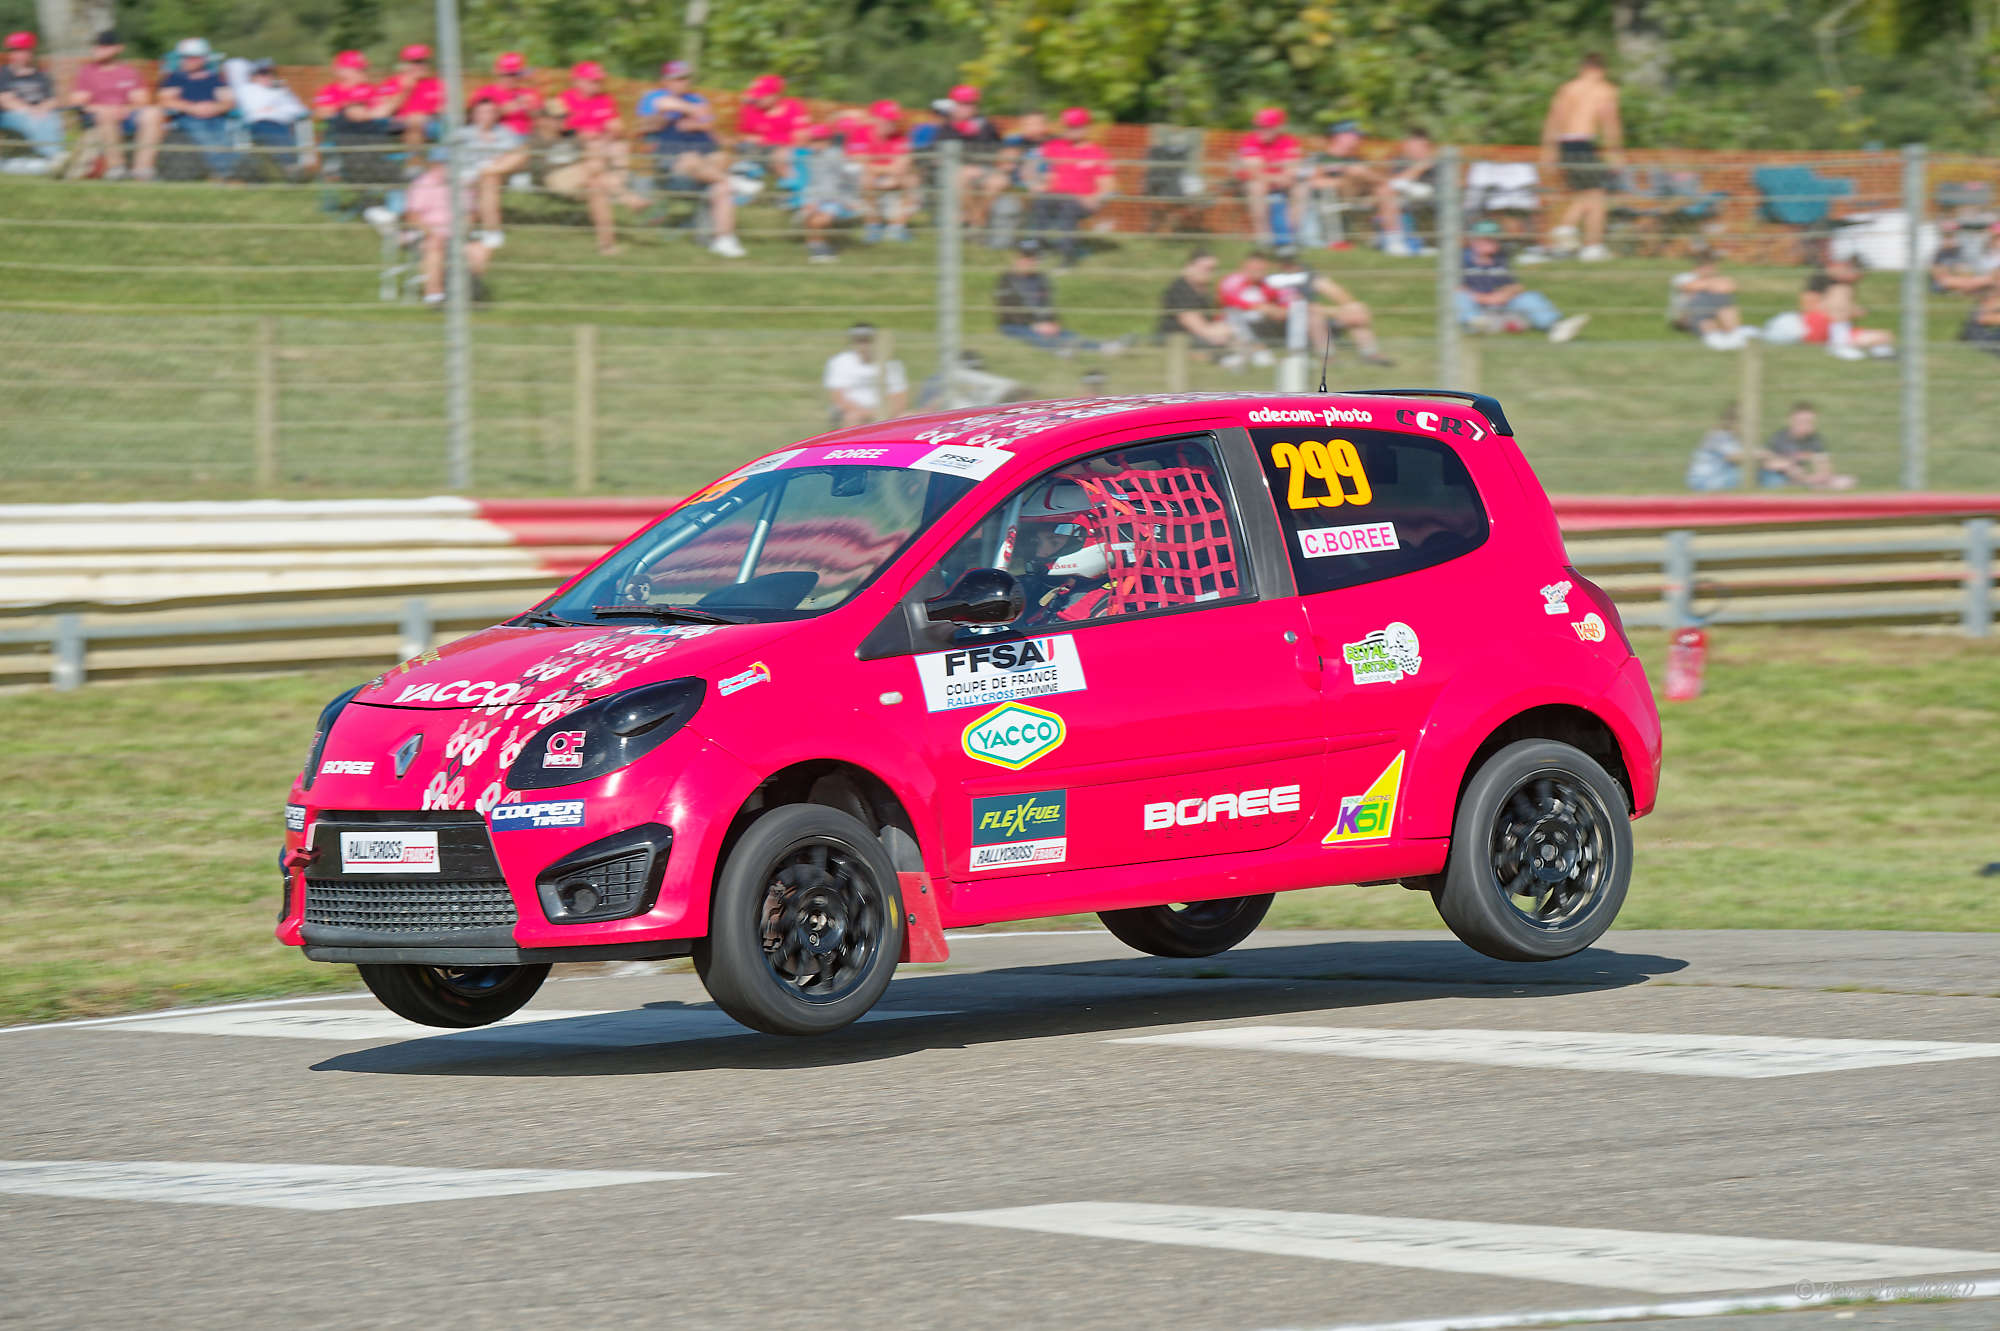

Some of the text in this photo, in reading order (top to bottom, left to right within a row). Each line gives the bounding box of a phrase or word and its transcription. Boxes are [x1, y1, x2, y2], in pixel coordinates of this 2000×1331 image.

[1248, 406, 1373, 427] adecom-photo
[823, 448, 889, 460] BOREE
[1270, 438, 1373, 510] 299
[1304, 526, 1394, 555] C.BOREE
[944, 641, 1045, 677] FFSA
[392, 679, 521, 704] YACCO
[946, 669, 1058, 696] COUPE DE FRANCE
[977, 721, 1052, 750] YACCO
[492, 801, 585, 821] COOPER
[532, 815, 581, 827] TIRES
[979, 797, 1061, 837] FLEXFUEL
[1144, 784, 1301, 831] BOREE
[977, 844, 1034, 865] RALLYCROSS
